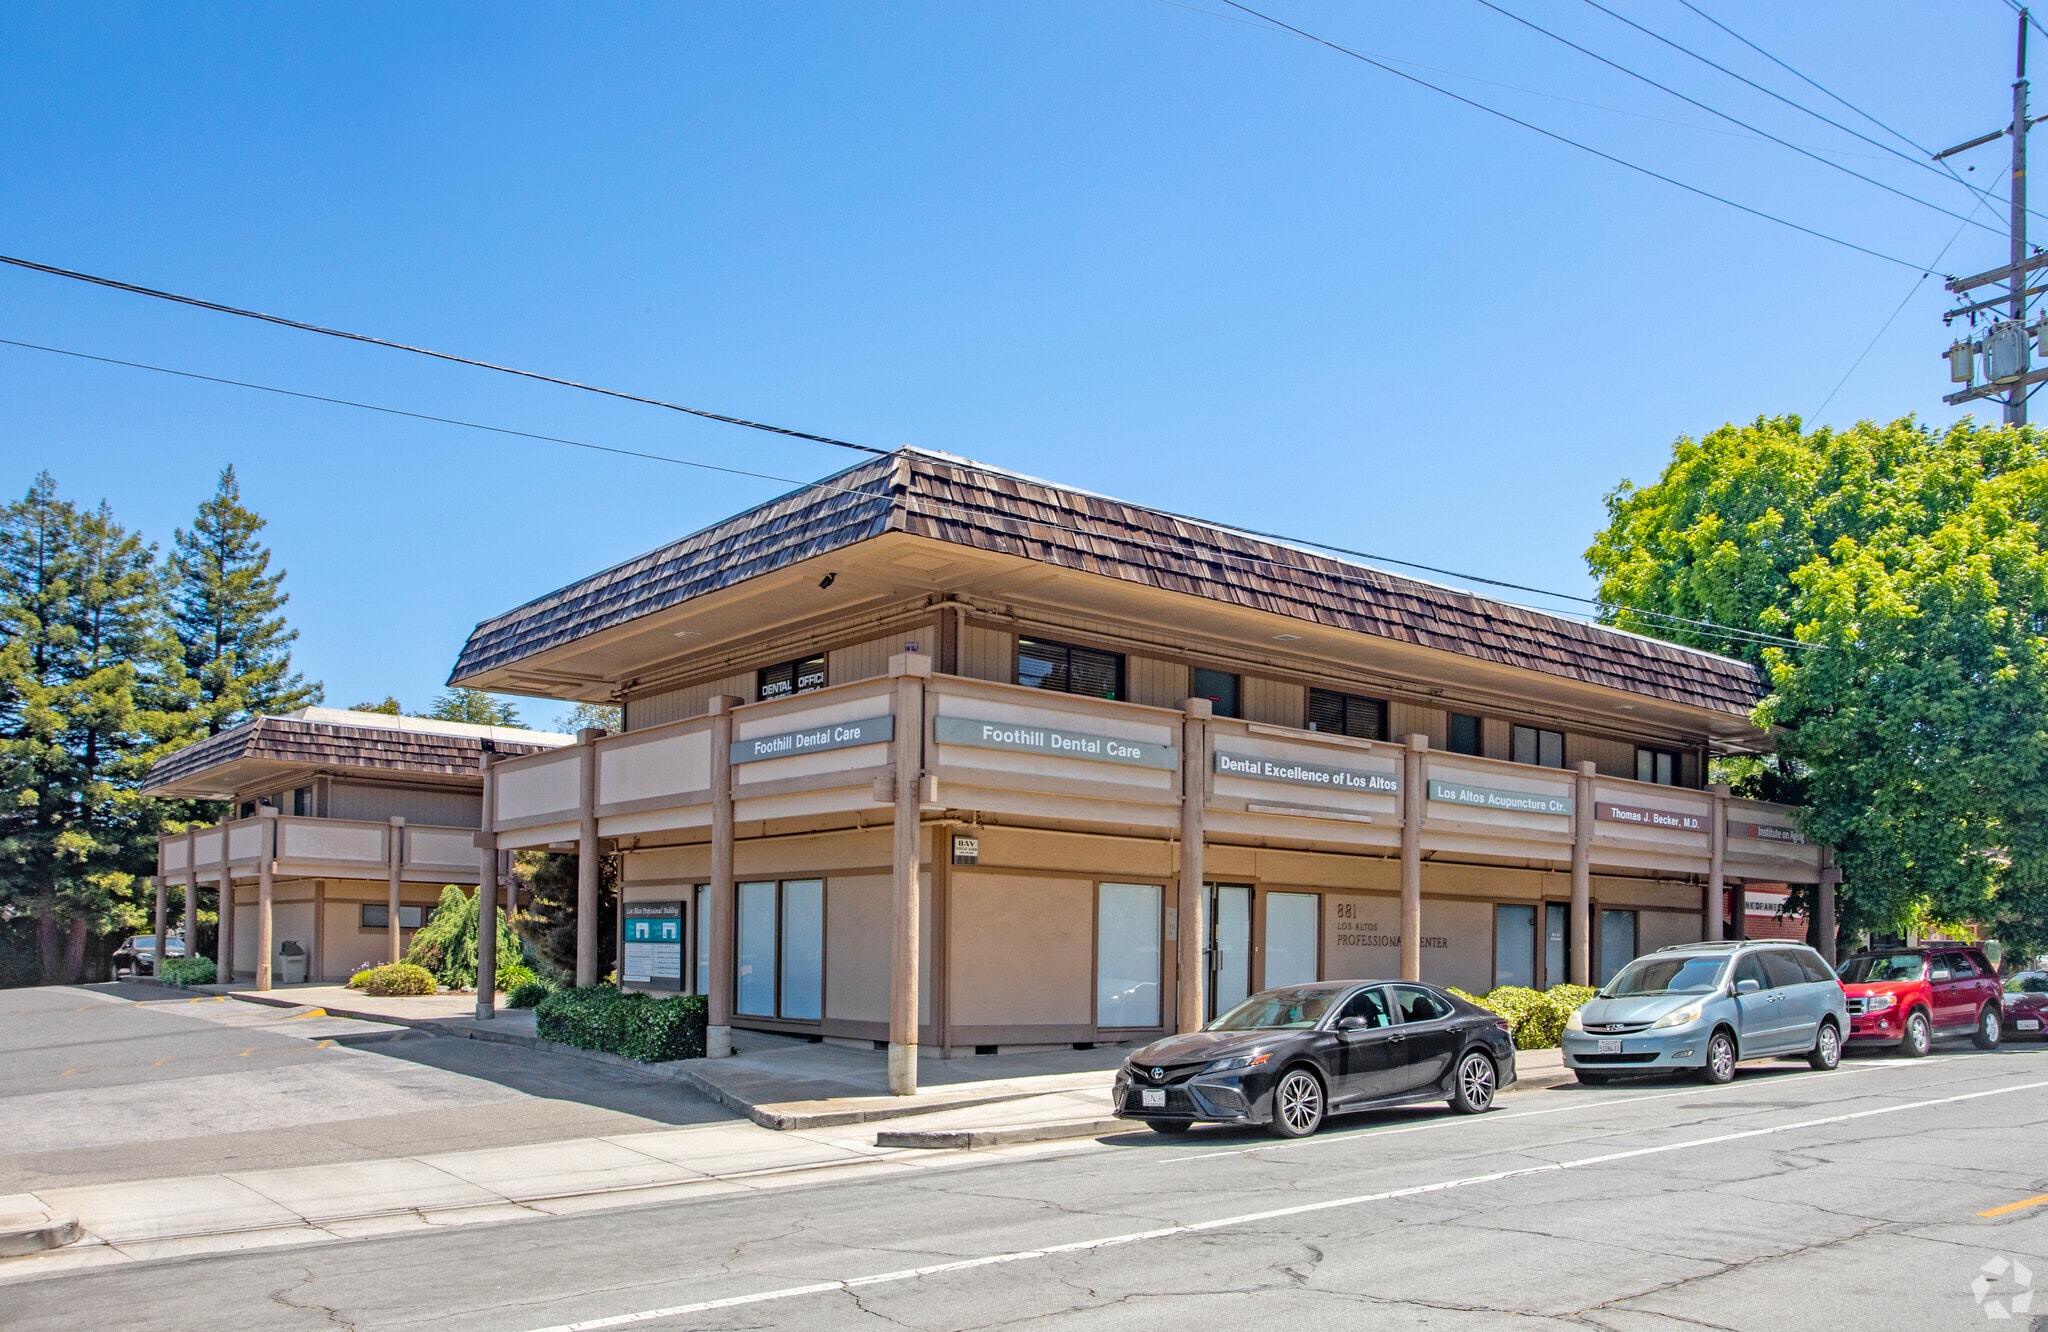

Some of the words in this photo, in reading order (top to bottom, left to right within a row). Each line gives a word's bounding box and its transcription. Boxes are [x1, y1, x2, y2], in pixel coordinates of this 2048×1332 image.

[762, 680, 792, 696] DENTAL
[754, 736, 792, 755] Foothill
[796, 729, 830, 748] Dental
[834, 727, 861, 742] Care
[982, 725, 1044, 746] Foothill
[1051, 734, 1100, 753] Dental
[1107, 741, 1141, 758] Care
[1221, 756, 1261, 775] Dental
[1265, 763, 1329, 783] Excellence
[1333, 772, 1345, 785] of
[1346, 773, 1366, 787] Los
[1369, 776, 1397, 791] Altos
[1438, 786, 1456, 799] Los
[1460, 789, 1485, 803] Altos
[1488, 794, 1546, 810] Acupuncture
[1549, 800, 1567, 812] Ctr.
[1611, 807, 1641, 821] Thomas
[1643, 812, 1651, 823] J.
[1653, 813, 1682, 828] Becker,
[1683, 817, 1700, 829] M.D.
[1757, 826, 1782, 839] Institute
[1782, 831, 1790, 839] on
[1337, 903, 1356, 919] 881
[1745, 901, 1755, 910] NK
[1337, 922, 1352, 931] LOS
[1355, 923, 1378, 932] ALTOS
[1337, 934, 1401, 947] PROFESSIONA
[1420, 937, 1448, 948] ENTER
